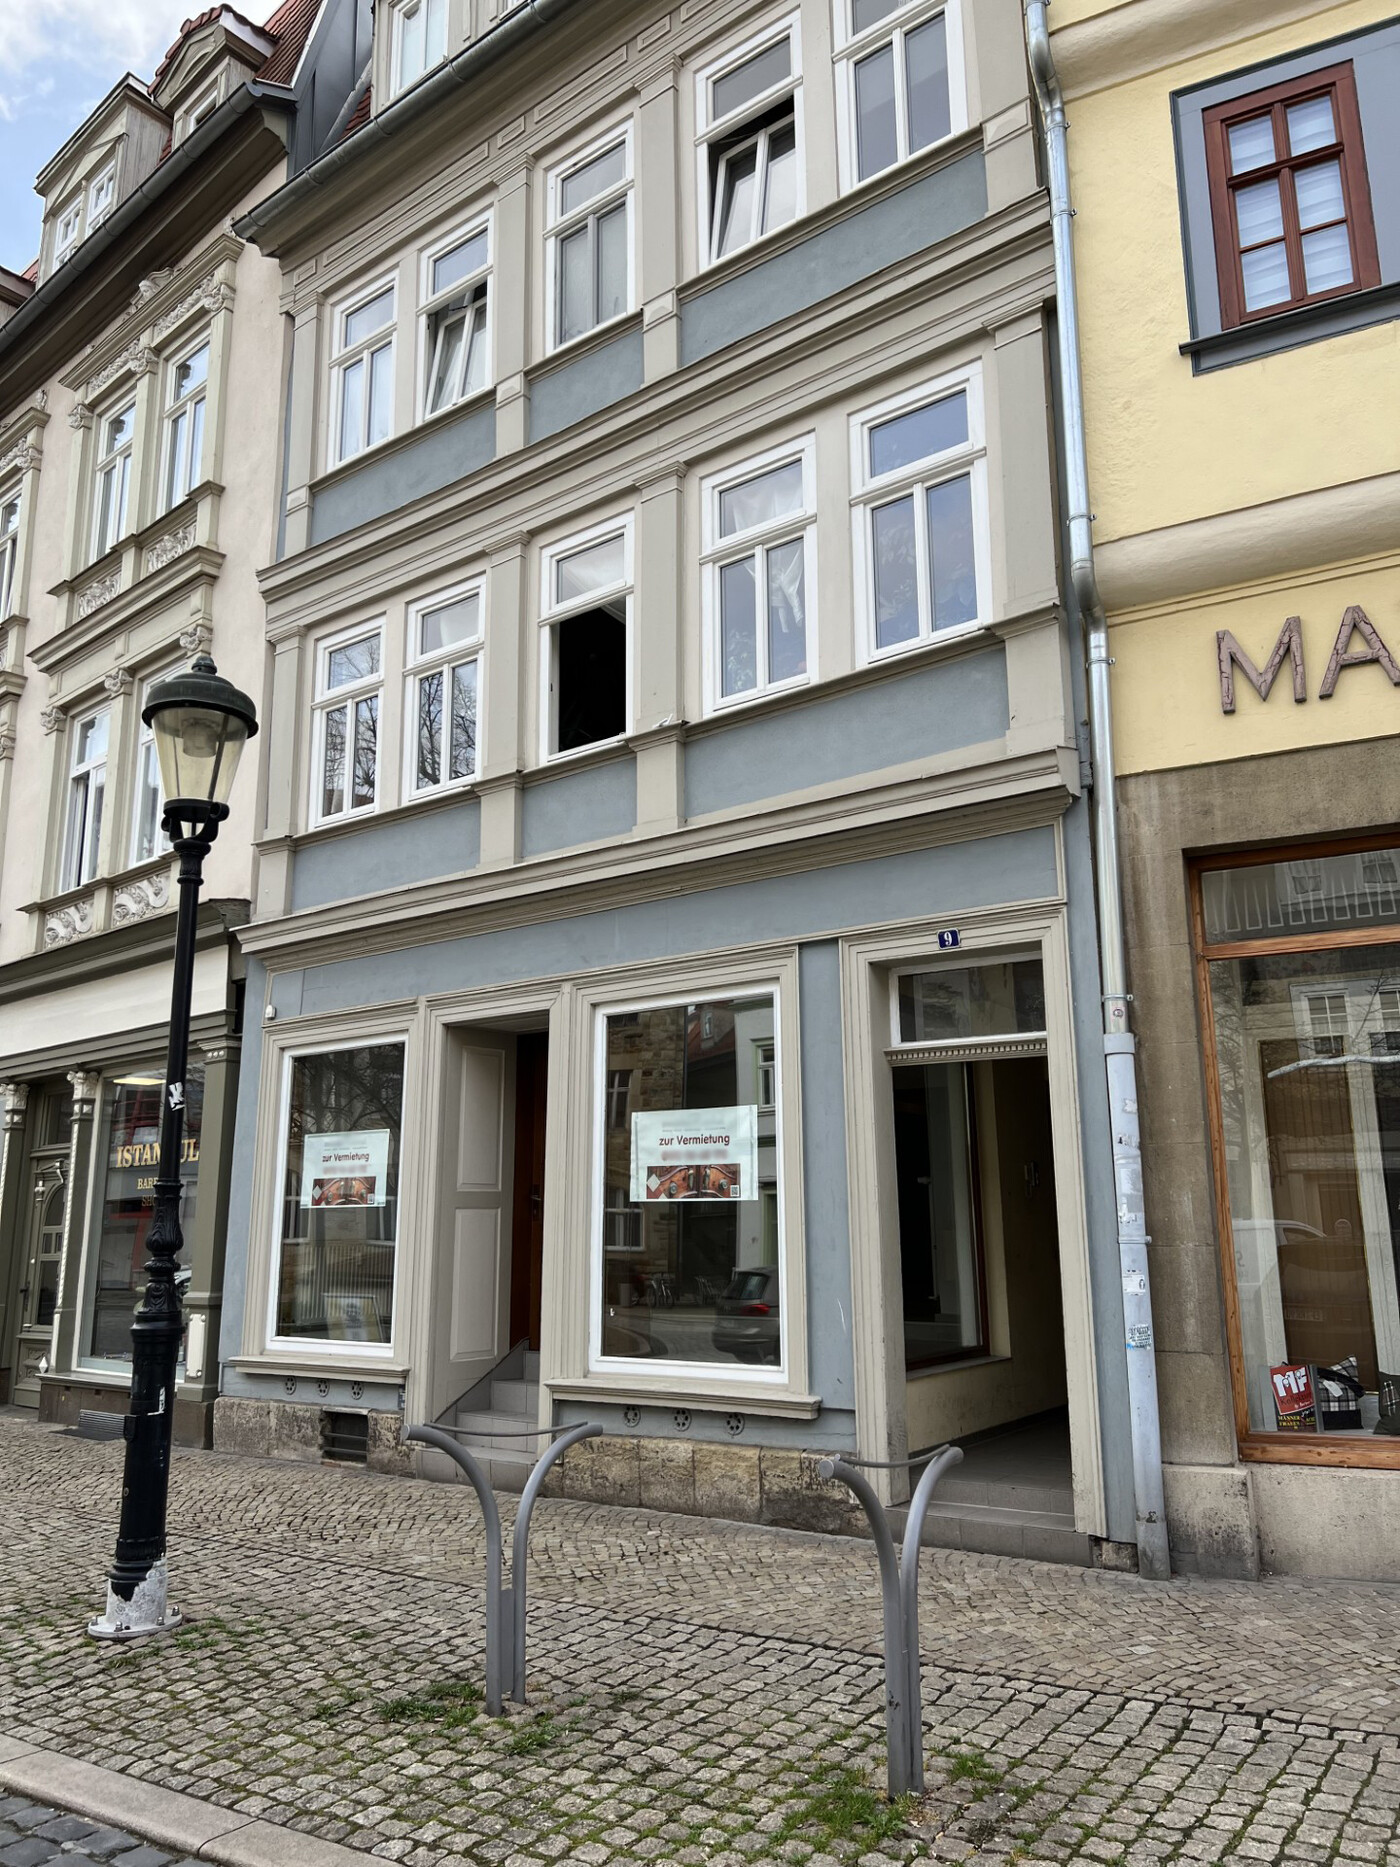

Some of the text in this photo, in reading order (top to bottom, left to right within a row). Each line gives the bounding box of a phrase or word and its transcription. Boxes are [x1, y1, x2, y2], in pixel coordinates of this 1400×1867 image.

[1216, 604, 1400, 715] MA
[943, 931, 953, 946] 9
[659, 1133, 731, 1147] zur Vermietung
[116, 1139, 199, 1168] ISTANUL
[333, 1152, 369, 1162] Vermietung
[1273, 1367, 1308, 1397] MF
